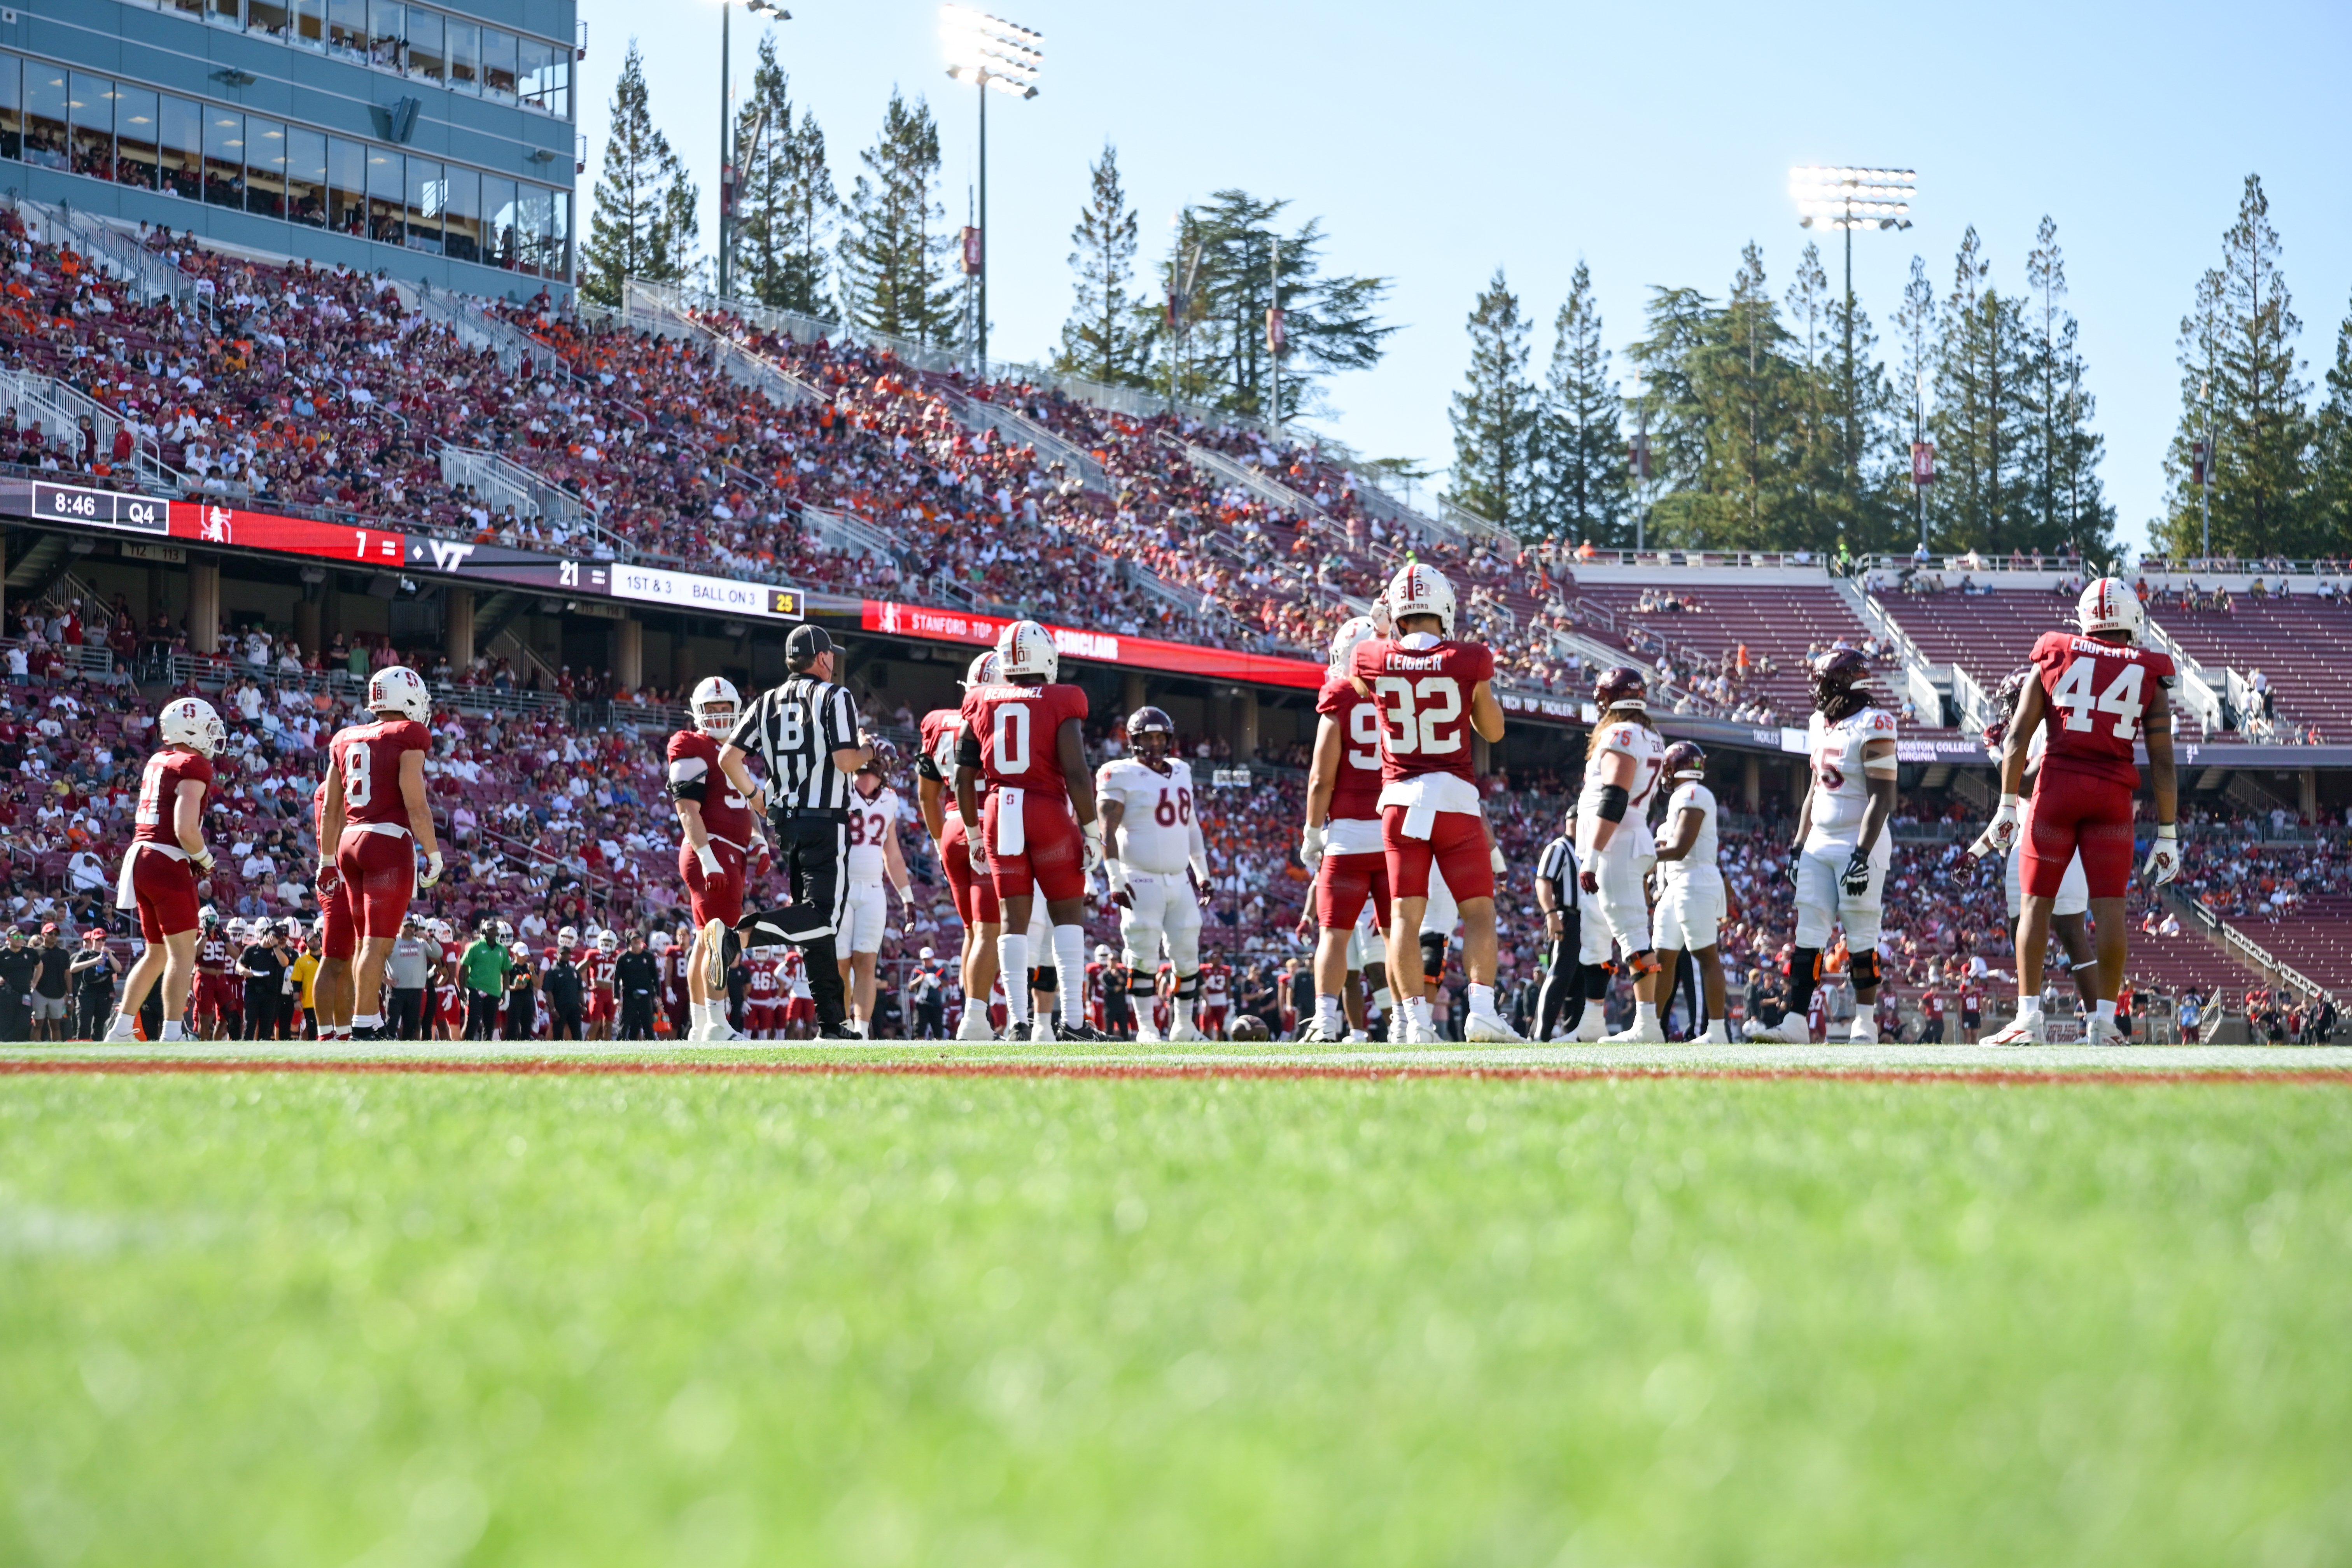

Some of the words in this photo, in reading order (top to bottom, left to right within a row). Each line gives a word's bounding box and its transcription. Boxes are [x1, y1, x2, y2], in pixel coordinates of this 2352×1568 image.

[55, 492, 95, 516] 8:46
[129, 502, 154, 524] Q4
[162, 548, 179, 561] 113
[356, 531, 366, 557] 7
[429, 539, 475, 572] VT
[560, 560, 579, 586] 21
[627, 576, 649, 590] 1ST
[653, 579, 661, 592] &
[666, 581, 672, 594] 3
[693, 584, 724, 602] BALL
[729, 590, 746, 605] ON
[749, 593, 755, 605] 3
[777, 594, 793, 612] 25
[912, 612, 967, 635] STANFORD
[971, 621, 992, 639] TOP
[1054, 629, 1118, 660] SINCLAIR
[2071, 638, 2121, 658] COOPER
[2124, 648, 2139, 660] IV
[1502, 695, 1522, 710] TECH
[1523, 697, 1539, 712] TOP
[2052, 656, 2146, 740] 44
[1375, 676, 1462, 754] 32
[1874, 716, 1894, 730] 65
[778, 703, 804, 751] B
[1610, 729, 1633, 746] 75
[1753, 729, 1780, 745] TACKLES
[994, 703, 1030, 775] 0
[1897, 741, 1935, 752] BOSTON
[1936, 741, 1977, 752] COLLEGE
[1897, 751, 1938, 761] VIRGINIA
[345, 742, 371, 807] 8
[1690, 788, 1695, 801] 1
[1155, 787, 1191, 828] 68
[848, 813, 885, 847] 82
[203, 941, 225, 961] 95
[596, 963, 616, 983] 17
[751, 971, 771, 990] 46
